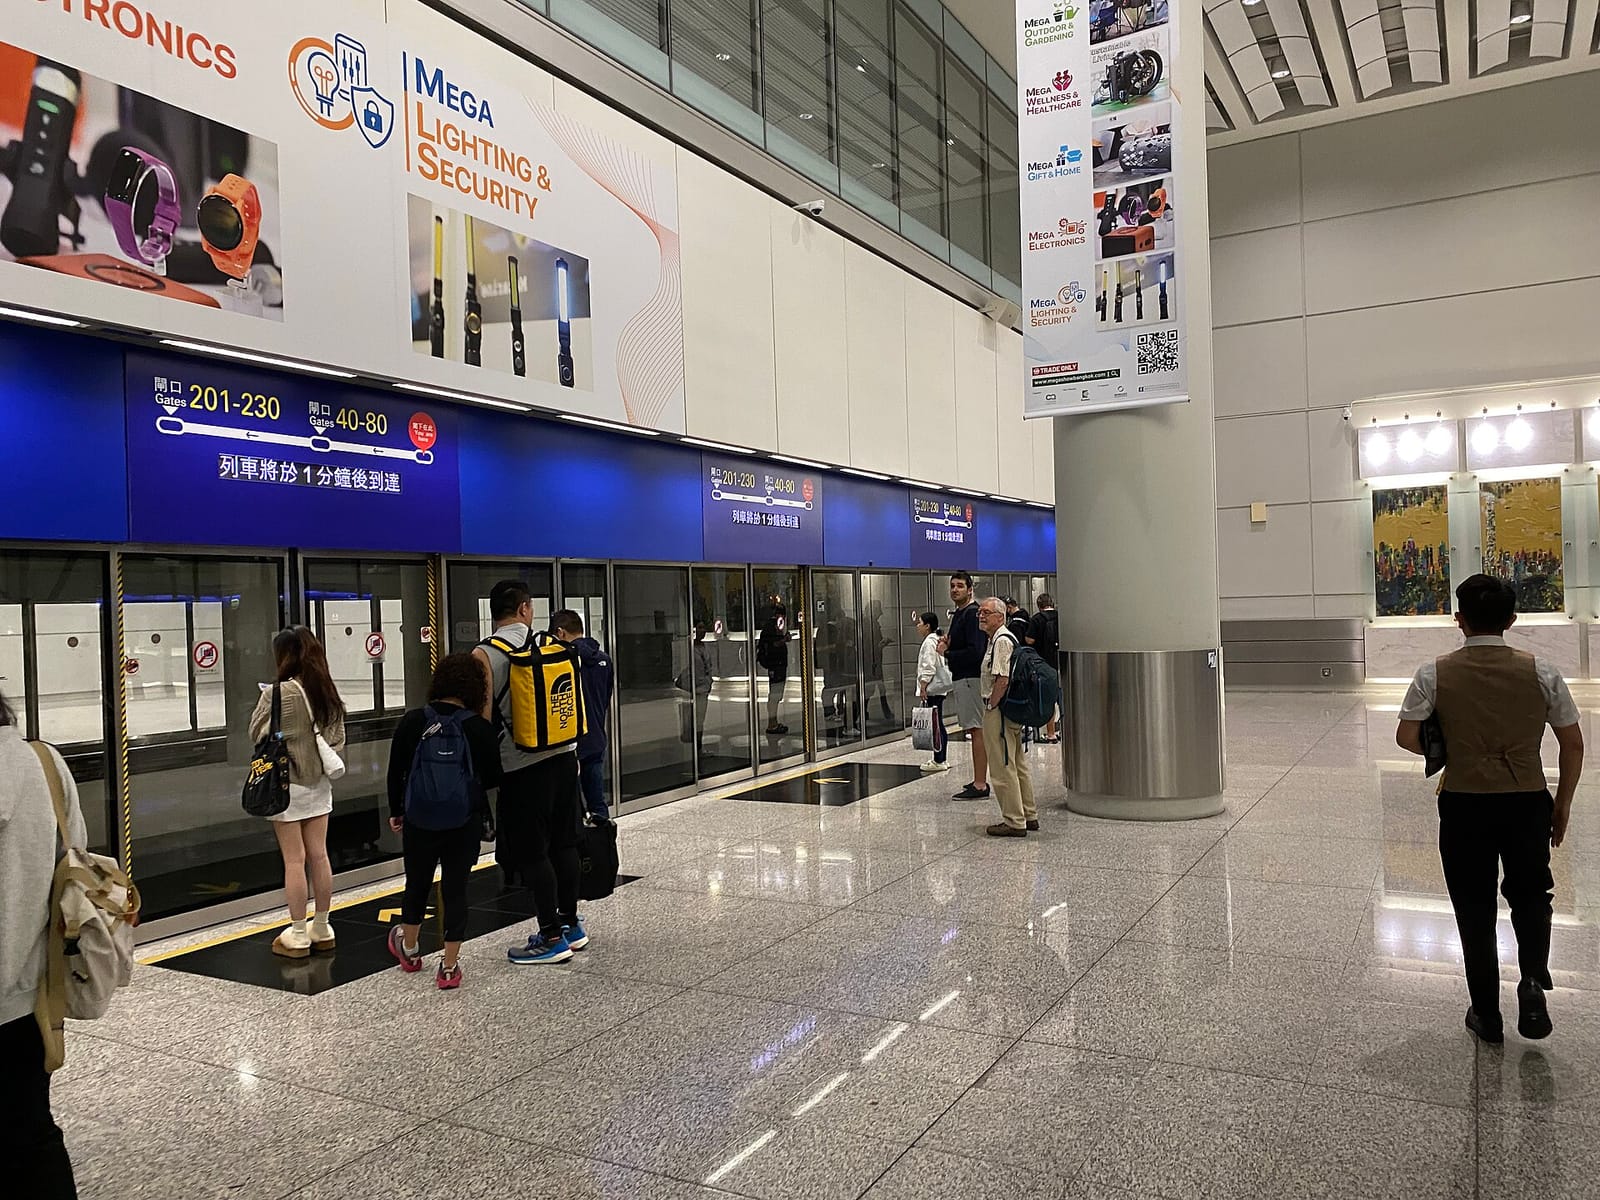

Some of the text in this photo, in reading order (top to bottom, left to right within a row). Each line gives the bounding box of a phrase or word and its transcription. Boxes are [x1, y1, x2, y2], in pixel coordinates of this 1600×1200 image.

[1024, 17, 1051, 29] MEGA
[1024, 22, 1074, 38] OUTDOOR &
[1024, 32, 1074, 47] GARDENING
[415, 57, 494, 129] MEGA
[1026, 86, 1052, 97] MEGA
[1026, 91, 1079, 106] WELLNESS &
[1026, 99, 1082, 116] HEALTHCARE
[416, 101, 552, 192] LIGHTING &
[1027, 161, 1054, 172] MEGA
[417, 142, 538, 220] SECURITY
[1028, 231, 1055, 241] MEGA
[1028, 236, 1086, 251] ELECTRONICS
[1030, 299, 1057, 309] MEGA
[1030, 306, 1077, 318] LIGHTING &
[1030, 315, 1072, 327] SECURITY
[154, 376, 182, 394] 閘口
[155, 393, 187, 408] Gates
[189, 384, 280, 420] 201-230
[309, 415, 335, 428] Gates
[335, 408, 388, 435] 40-80
[219, 455, 400, 492] 列車將於 1 分鐘後到達
[723, 470, 755, 488] 201-230
[775, 478, 795, 494] 40-80
[551, 694, 559, 716] THE
[560, 692, 568, 729] NORTH
